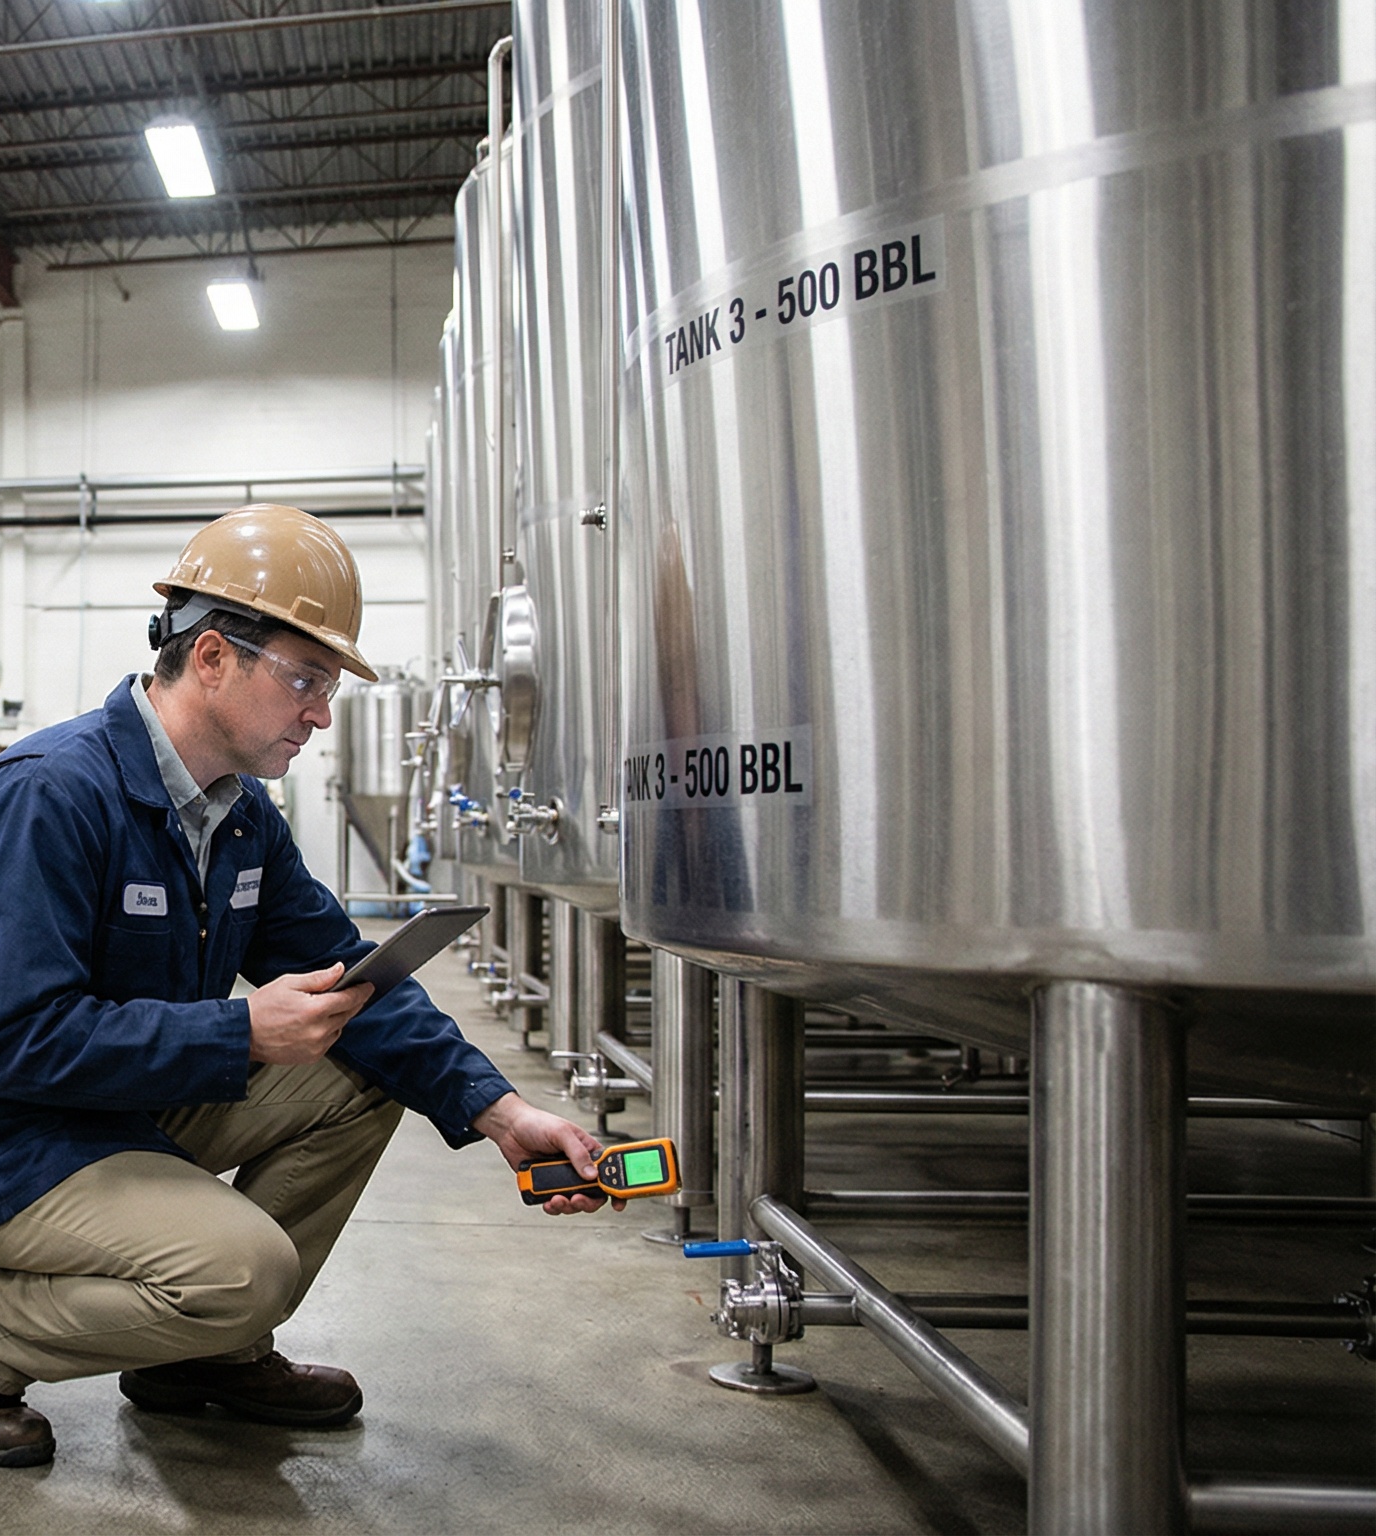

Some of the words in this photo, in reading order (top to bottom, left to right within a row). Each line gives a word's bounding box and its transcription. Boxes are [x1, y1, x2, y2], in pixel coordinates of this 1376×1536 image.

[665, 307, 722, 374] TANK
[729, 298, 745, 344] 3
[755, 309, 767, 319] -
[778, 262, 840, 325] 500
[854, 235, 935, 300] BBL
[624, 754, 651, 801] ANK
[655, 753, 665, 799] 3
[671, 775, 678, 783] -
[686, 746, 729, 798] 500
[740, 741, 803, 795] BBL
